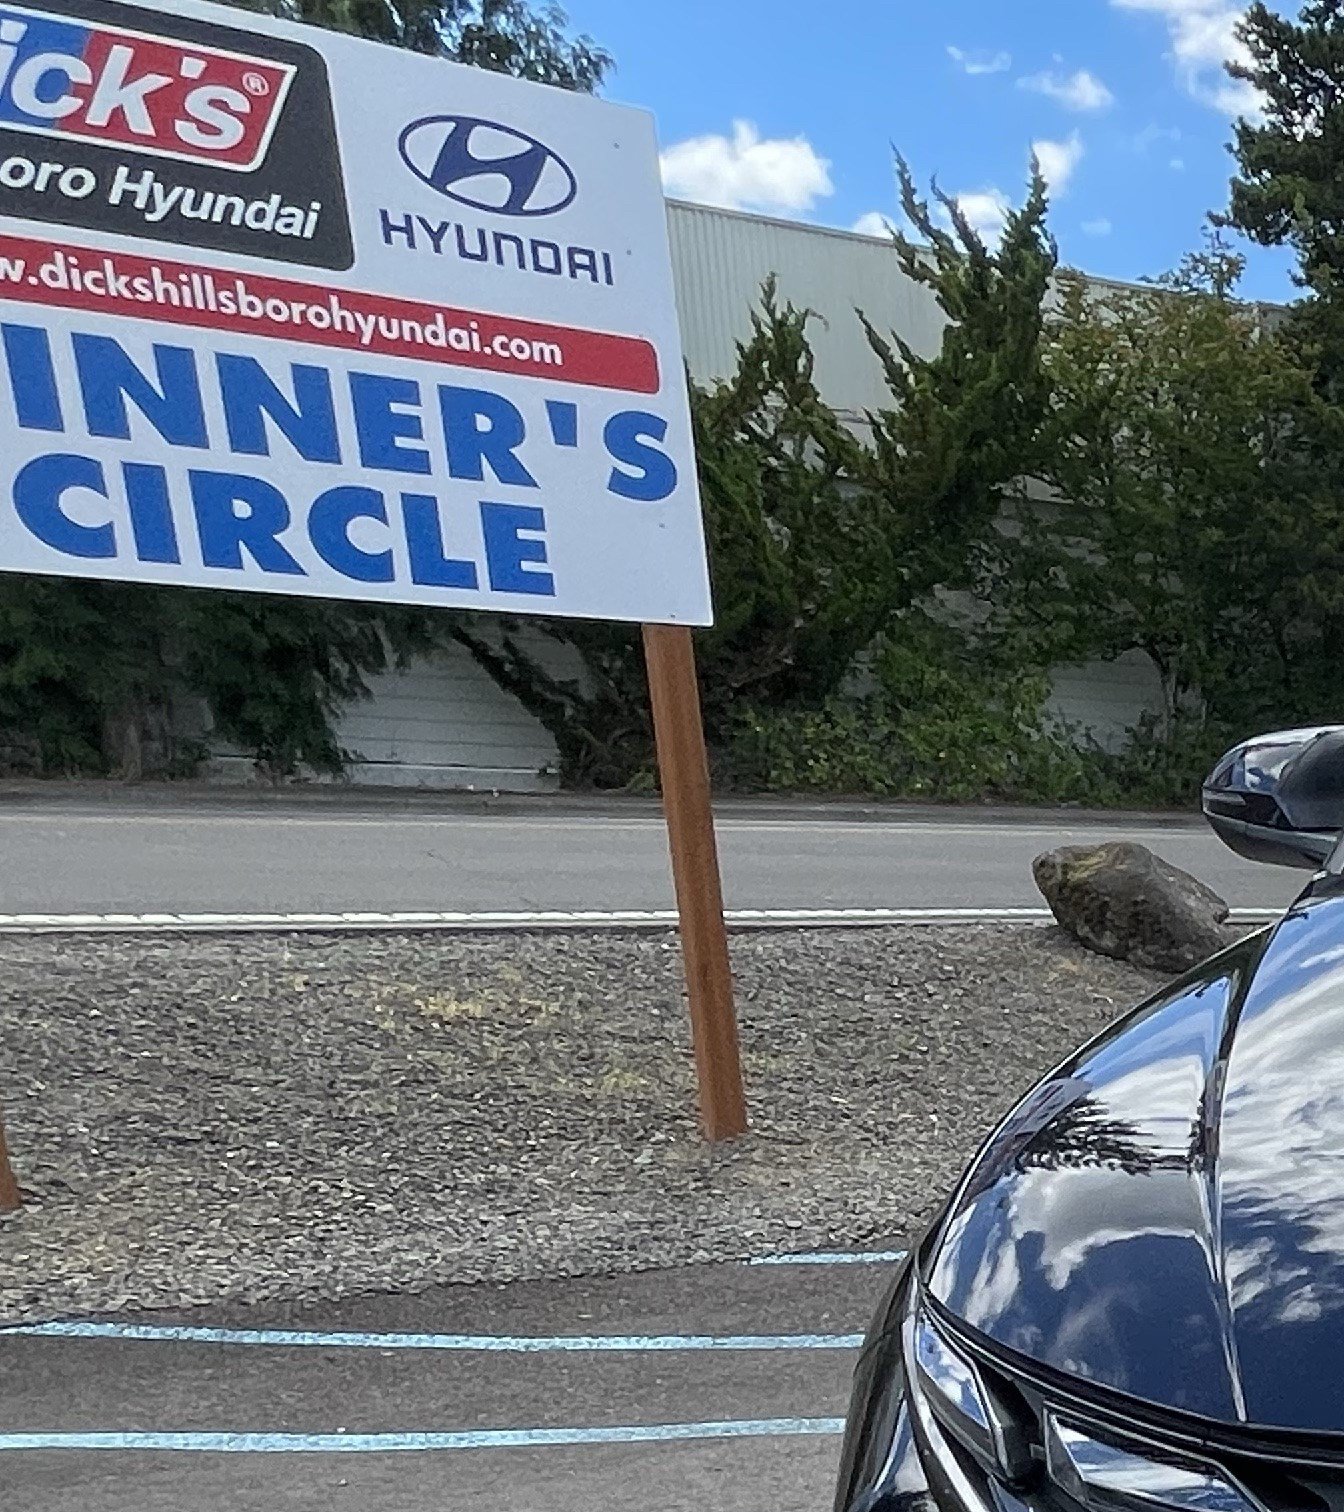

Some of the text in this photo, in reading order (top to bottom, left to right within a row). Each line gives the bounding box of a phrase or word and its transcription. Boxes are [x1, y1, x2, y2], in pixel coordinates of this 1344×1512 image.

[108, 166, 321, 240] Hyundai
[380, 209, 614, 285] HYUNDAI
[1, 322, 678, 502] INNER'S
[12, 453, 556, 597] CIRCLE
